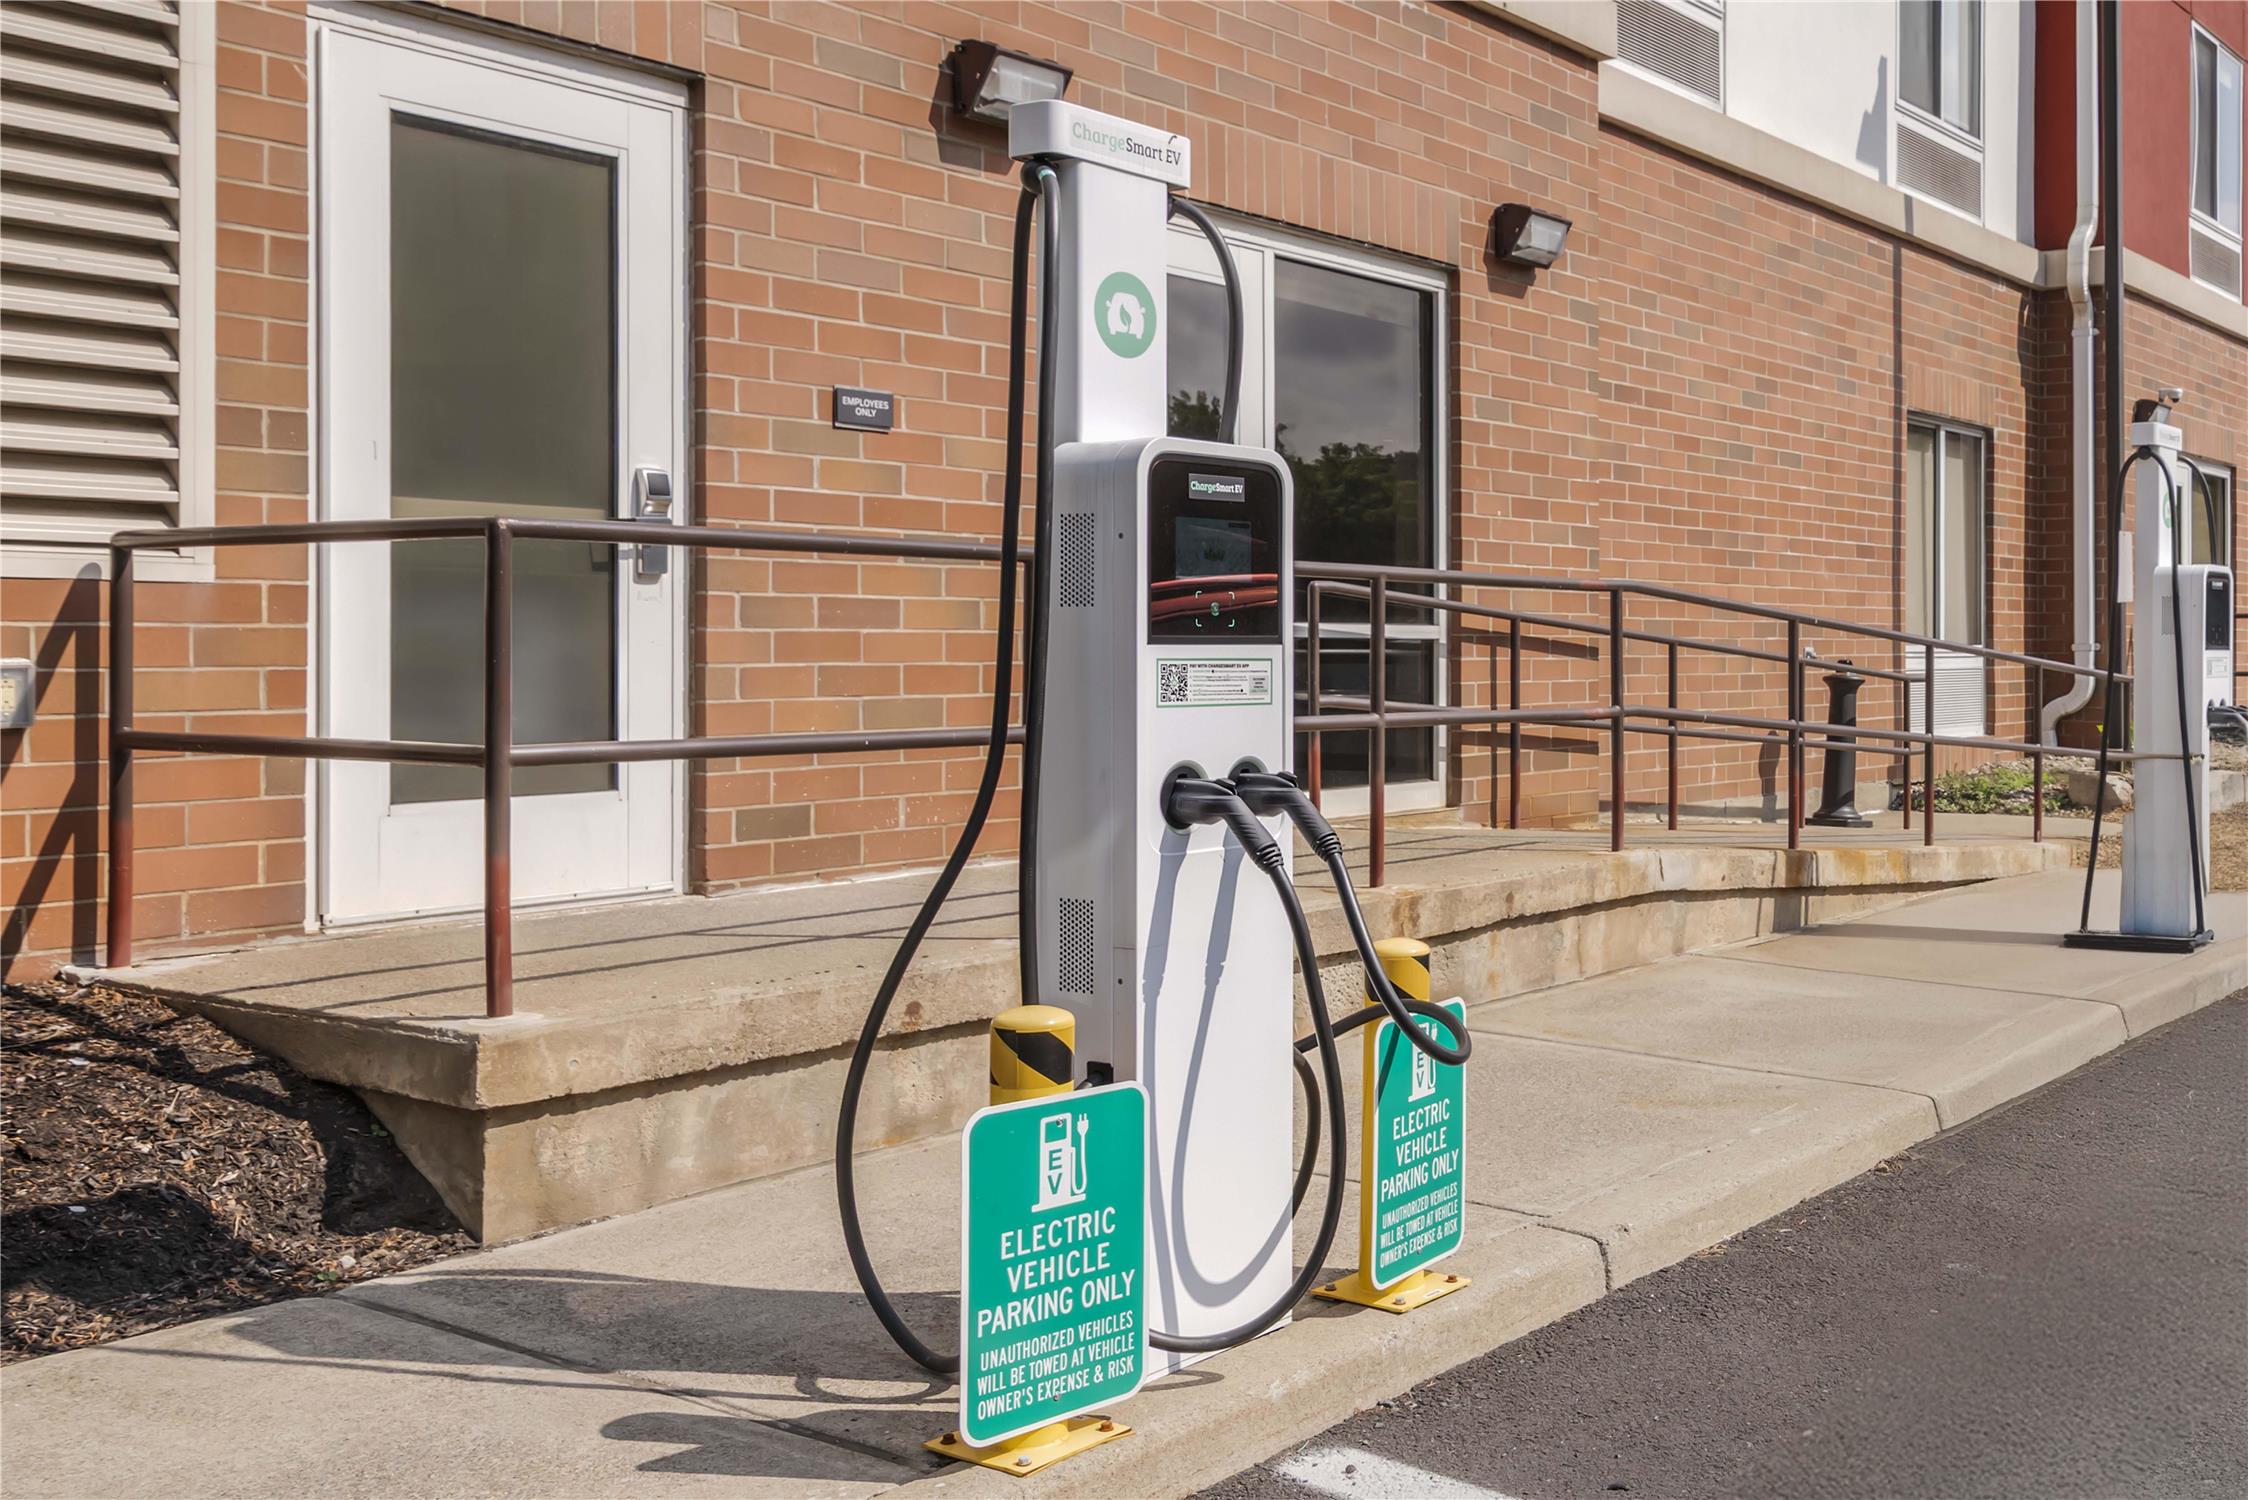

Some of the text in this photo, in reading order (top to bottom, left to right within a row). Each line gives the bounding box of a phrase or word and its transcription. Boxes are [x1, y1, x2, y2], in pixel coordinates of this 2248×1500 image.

[1072, 122, 1181, 166] ChargeSmart EV
[842, 396, 889, 410] EMPLOYEES
[855, 407, 877, 417] ONLY
[1190, 480, 1243, 494] ChargeSmart EV
[1393, 1098, 1450, 1141] ELECTRIC
[1396, 1126, 1447, 1167] VEHICLE
[1381, 1148, 1459, 1203] PARKING ONLY
[1380, 1198, 1458, 1250] WILL BE TOWED AT VEHICLE
[1382, 1181, 1457, 1230] UNAUTHORIZED VEHICLES
[1001, 1206, 1116, 1260] ELECTRIC
[1380, 1217, 1458, 1268] OWNER'S EXPENSE & RISK
[1007, 1242, 1110, 1293] VEHICLE
[977, 1269, 1136, 1338] PARKING ONLY
[977, 1332, 1135, 1397] WILL BE TOWED AT VEHICLE
[980, 1310, 1134, 1372] UNAUTHORIZED VEHICLES
[977, 1355, 1135, 1421] OWNER'S EXPENSE & RISK
